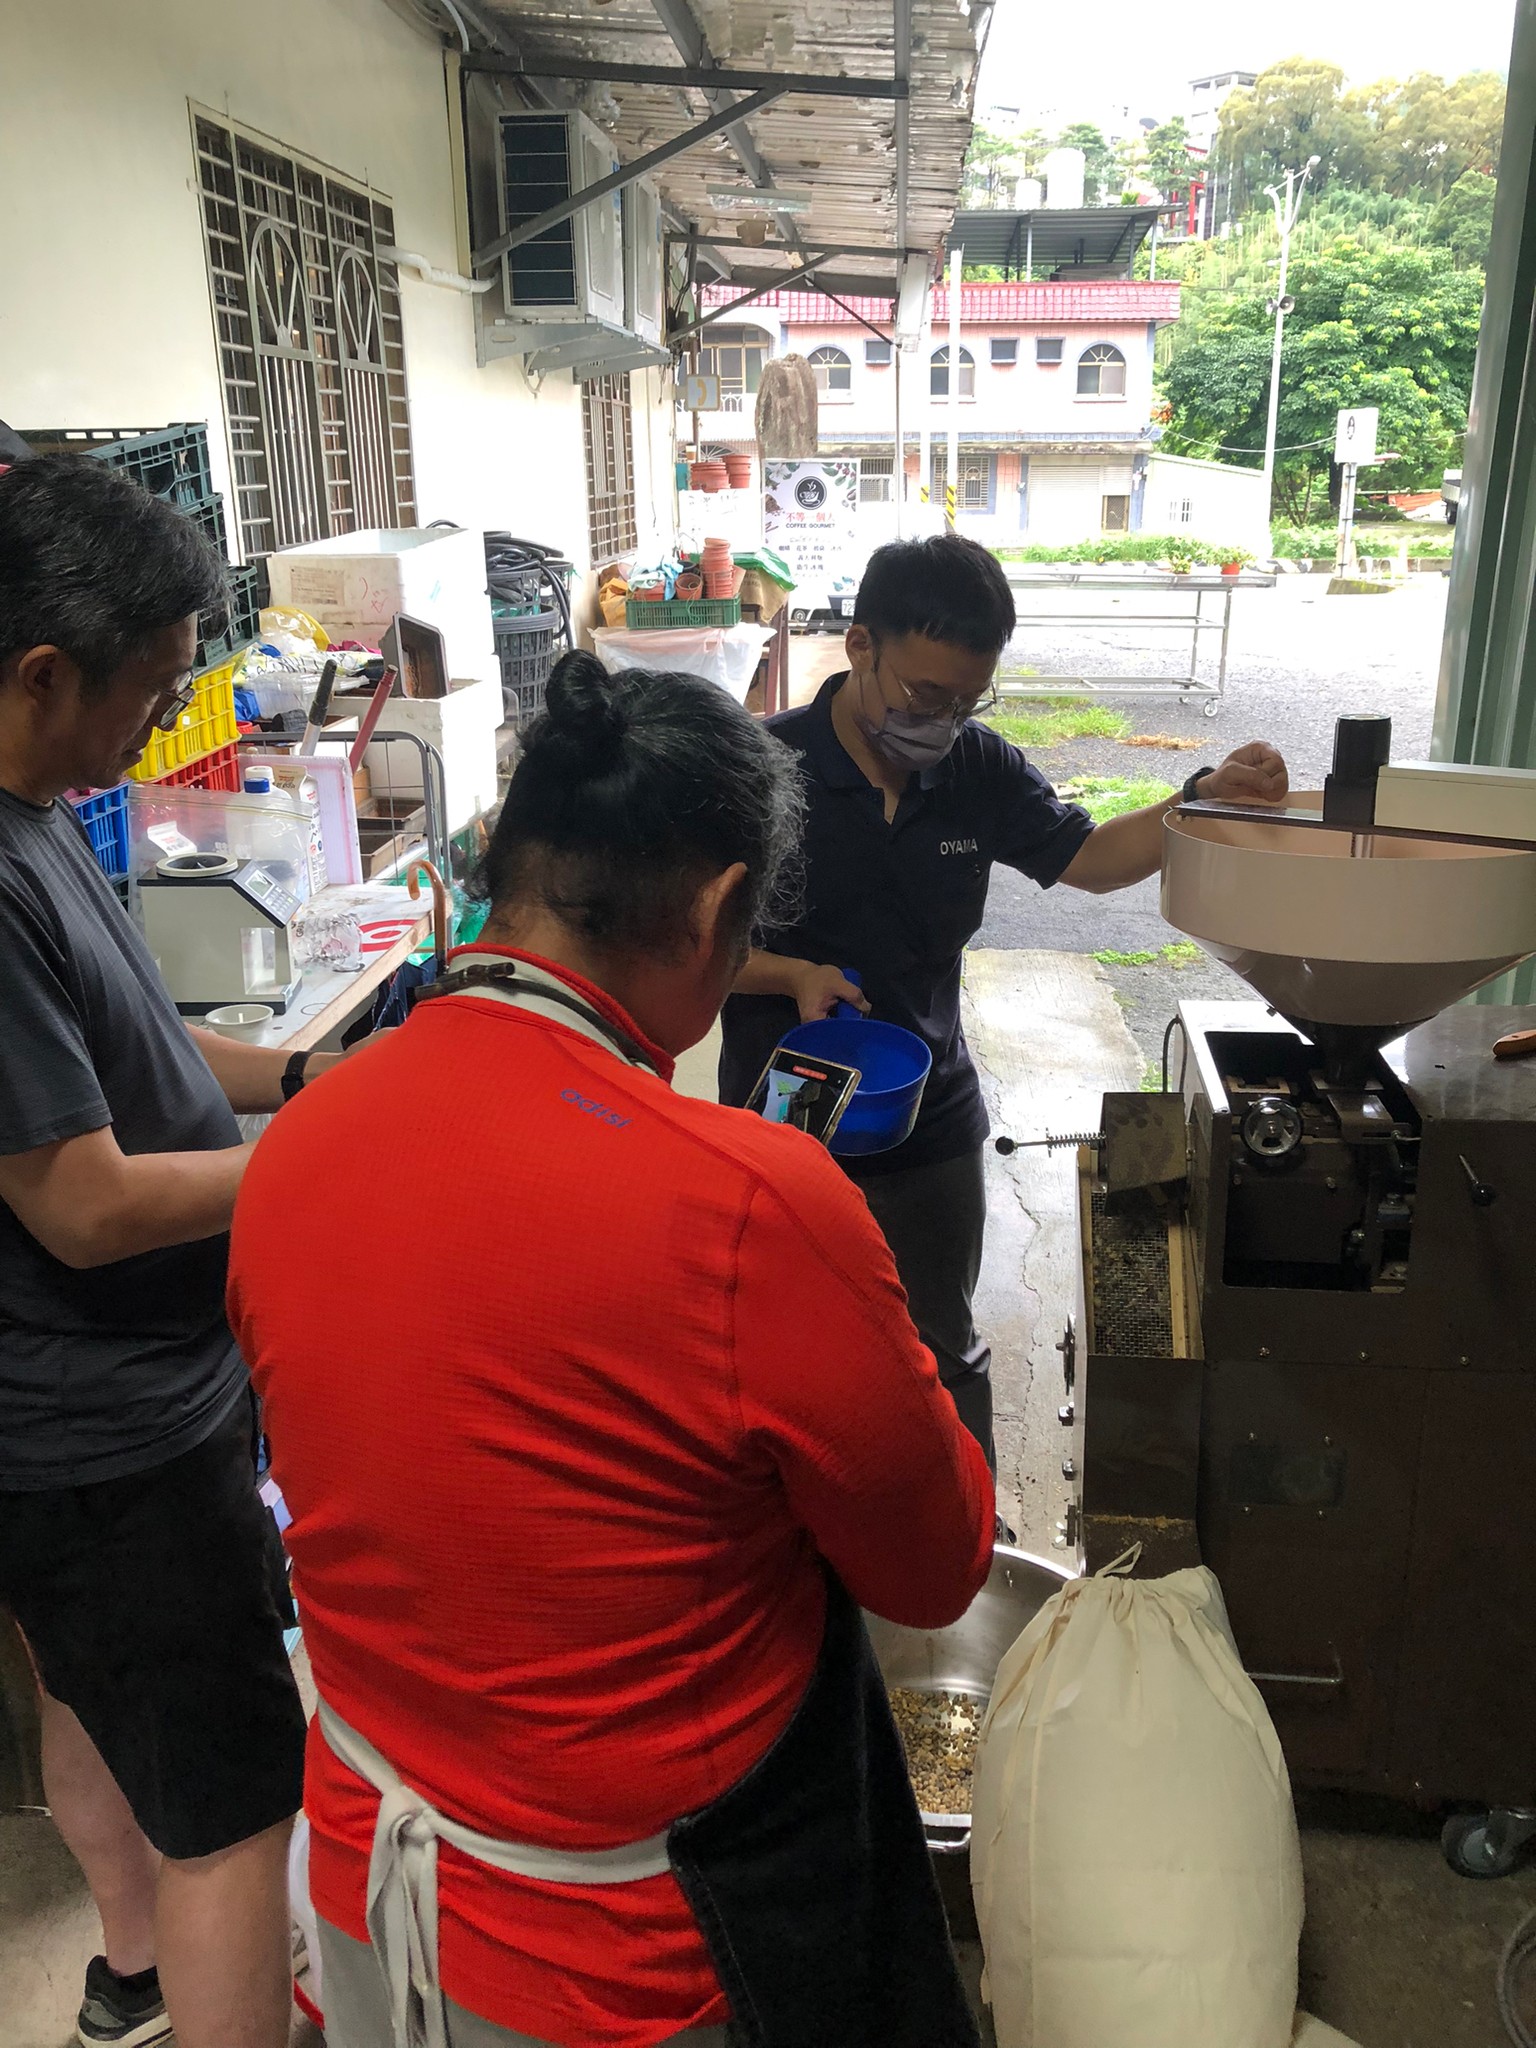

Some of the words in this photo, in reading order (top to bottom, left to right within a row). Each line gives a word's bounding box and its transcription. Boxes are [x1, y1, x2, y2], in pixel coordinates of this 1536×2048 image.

[785, 512, 835, 523] 不等一個人
[940, 838, 978, 855] OYAMA
